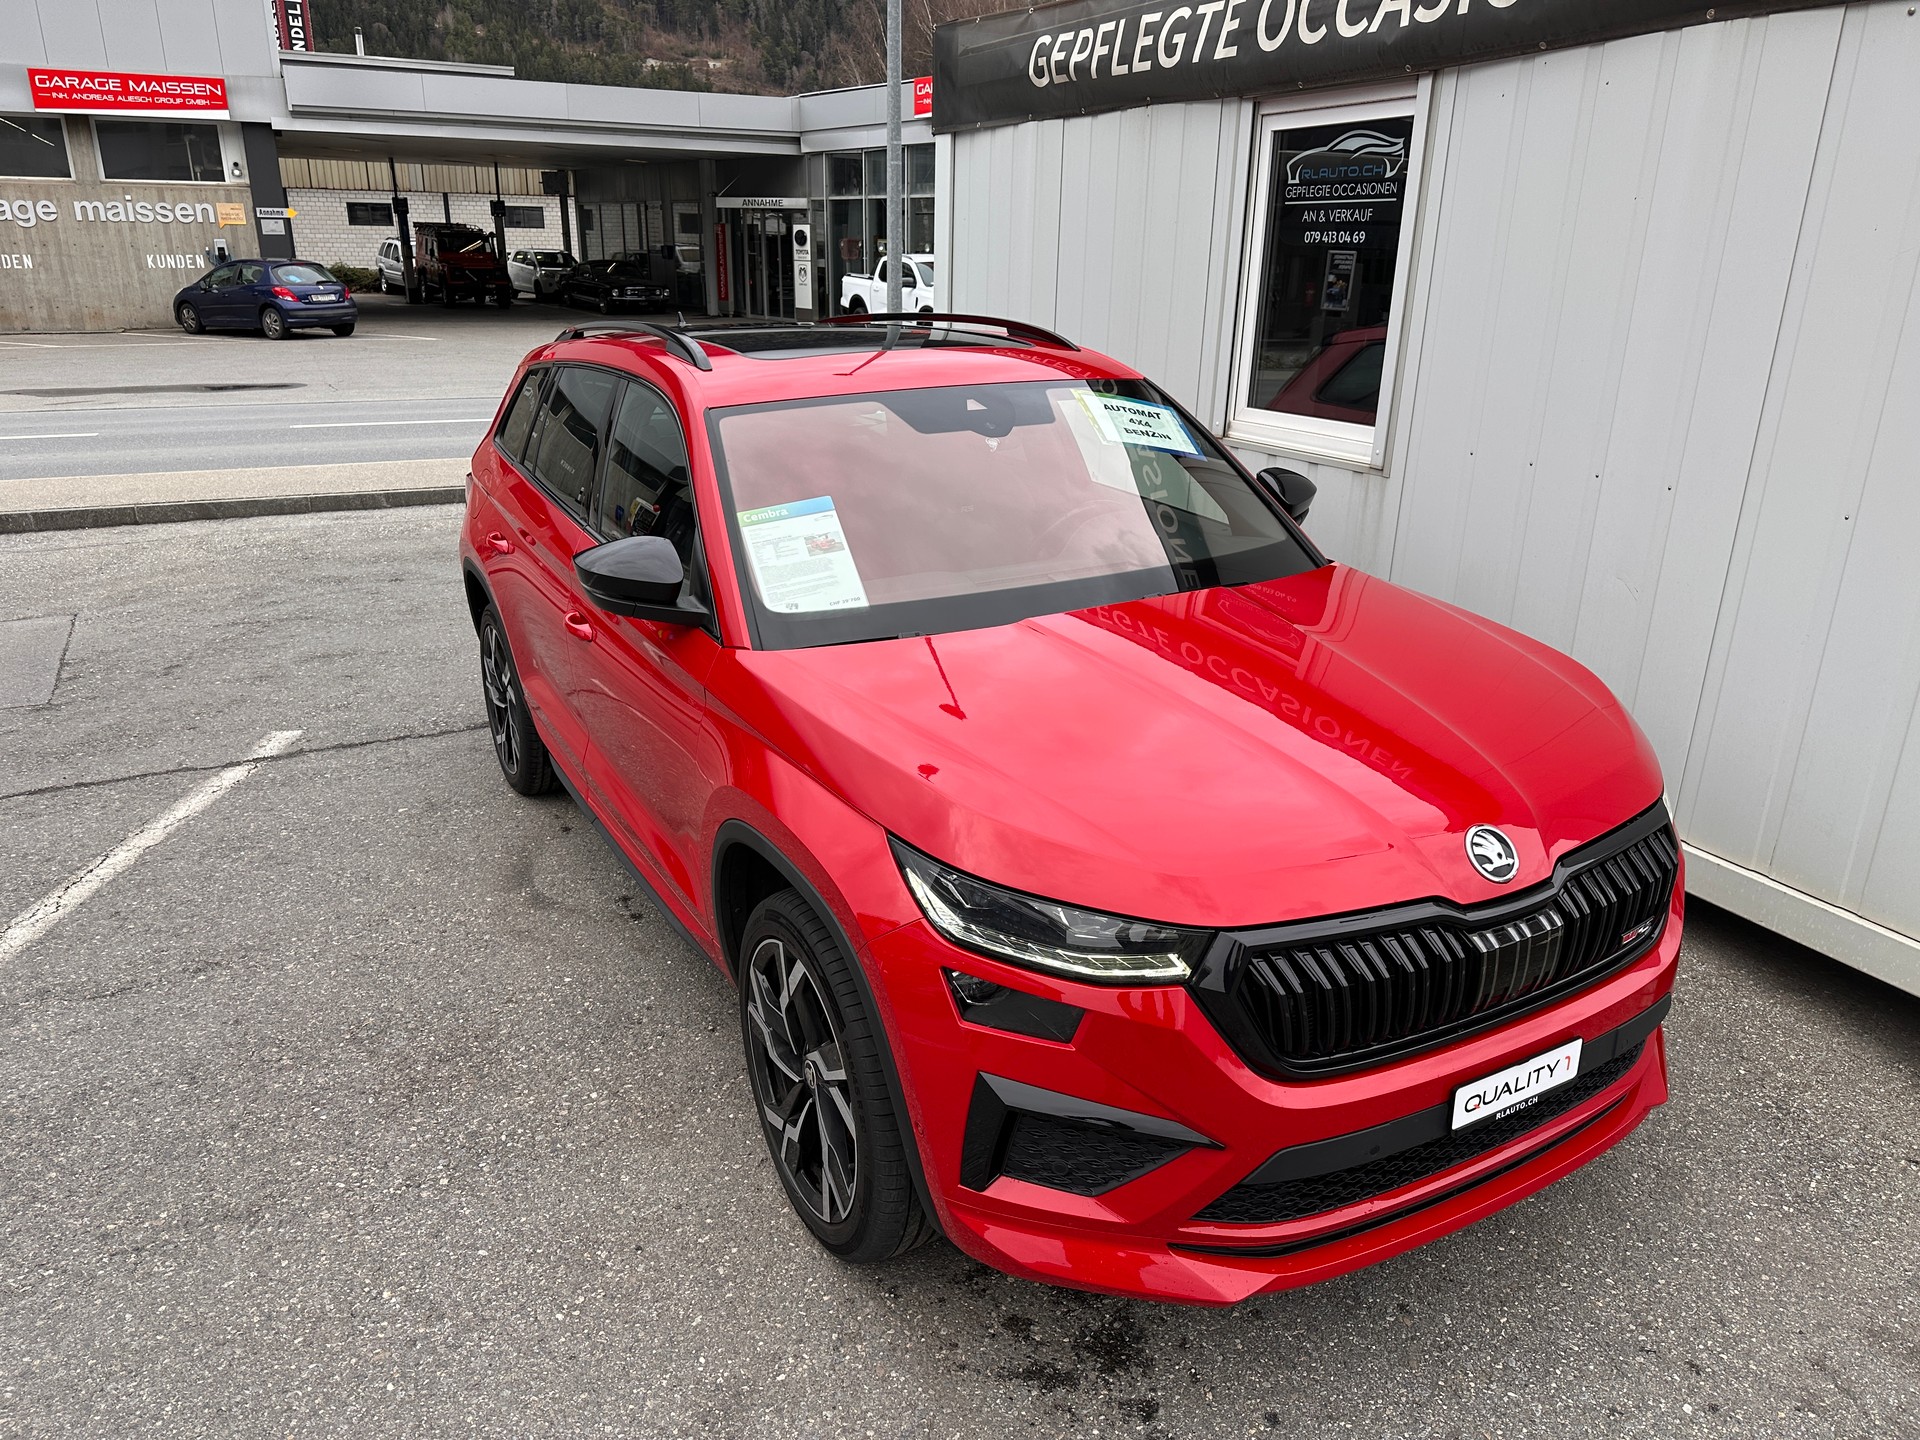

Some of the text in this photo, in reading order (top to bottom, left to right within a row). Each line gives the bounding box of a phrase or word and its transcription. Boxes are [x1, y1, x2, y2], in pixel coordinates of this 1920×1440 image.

[285, 0, 306, 51] NDEL
[1029, 0, 1518, 88] GEPFLEGTE OCCA
[34, 75, 222, 96] GARAGE MAISSEN
[72, 93, 115, 102] ANDREAS
[154, 96, 184, 104] GROUP
[1301, 164, 1384, 179] RLAUTO.CH
[1285, 181, 1398, 198] GEPFLEGTE OCCASIONEN
[73, 195, 216, 223] maissen
[742, 199, 784, 207] ANNAHME
[1302, 208, 1373, 222] AN & VERKAUF
[1304, 231, 1366, 243] 079 413 04 69
[0, 254, 34, 269] DEN
[146, 254, 206, 270] KUNDEN
[1103, 403, 1161, 420] AUTOMAT
[1123, 427, 1172, 440] BENZIN
[743, 508, 789, 523] Cembra
[1464, 1055, 1571, 1113] QUALITY 1
[1495, 1096, 1539, 1120] RLAUTO.CH
